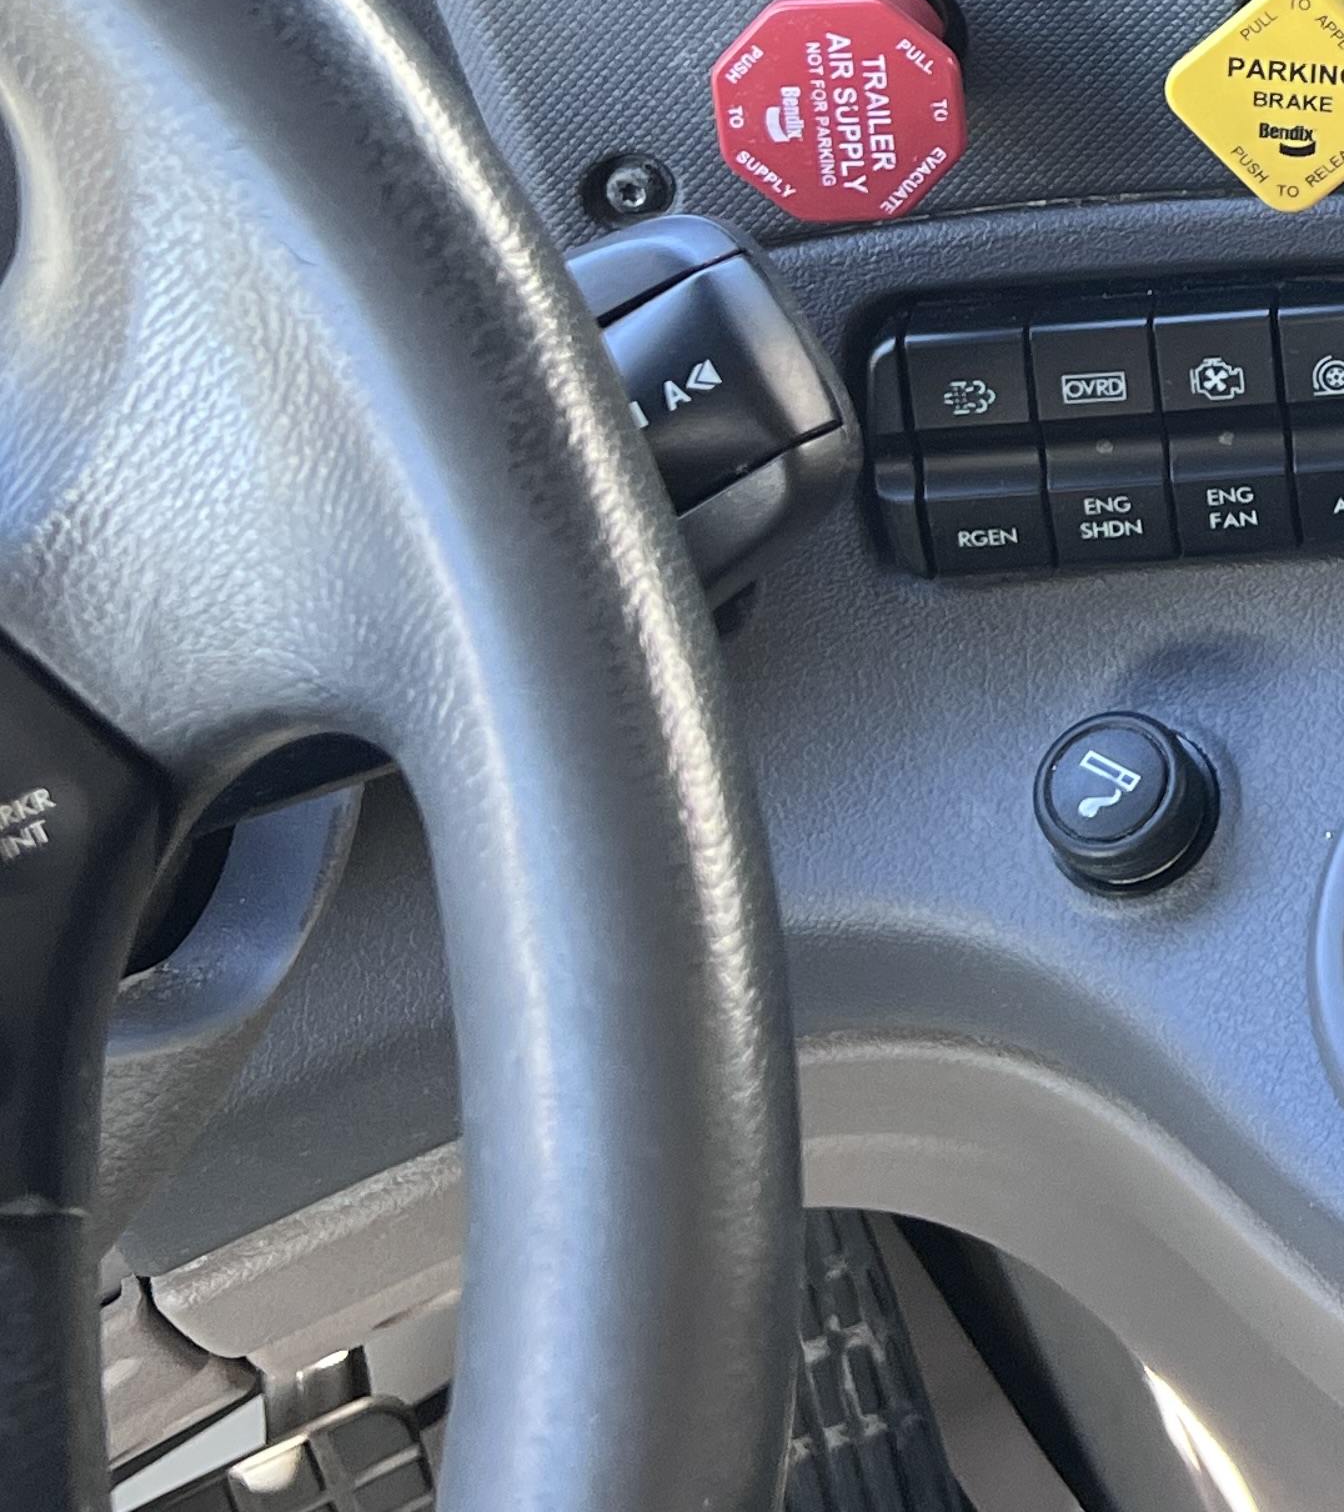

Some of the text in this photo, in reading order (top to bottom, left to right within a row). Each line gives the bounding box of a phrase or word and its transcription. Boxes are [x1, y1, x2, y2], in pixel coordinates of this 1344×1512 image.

[1240, 11, 1278, 40] PULL
[725, 45, 763, 83] PUSH
[896, 39, 934, 75] PULL
[780, 86, 804, 141] Bendix
[806, 42, 837, 186] NOT FOR PARKING
[826, 32, 868, 194] AIR SUPPLY
[862, 54, 896, 171] TRAILER
[931, 99, 948, 122] TO
[1253, 91, 1333, 113] BRAKE
[728, 106, 744, 129] TO
[1259, 123, 1313, 141] Bendix
[736, 150, 796, 198] SUPPLY
[1230, 146, 1269, 184] PUSH
[880, 146, 947, 215] EVACUATE
[1277, 184, 1299, 198] TO
[664, 380, 692, 411] A
[1065, 378, 1124, 398] OVRD
[1084, 496, 1132, 516] ENG
[1207, 487, 1255, 507] ENG
[1080, 519, 1143, 540] SHDN
[1209, 510, 1259, 530] FAN
[958, 528, 1018, 548] RGEN
